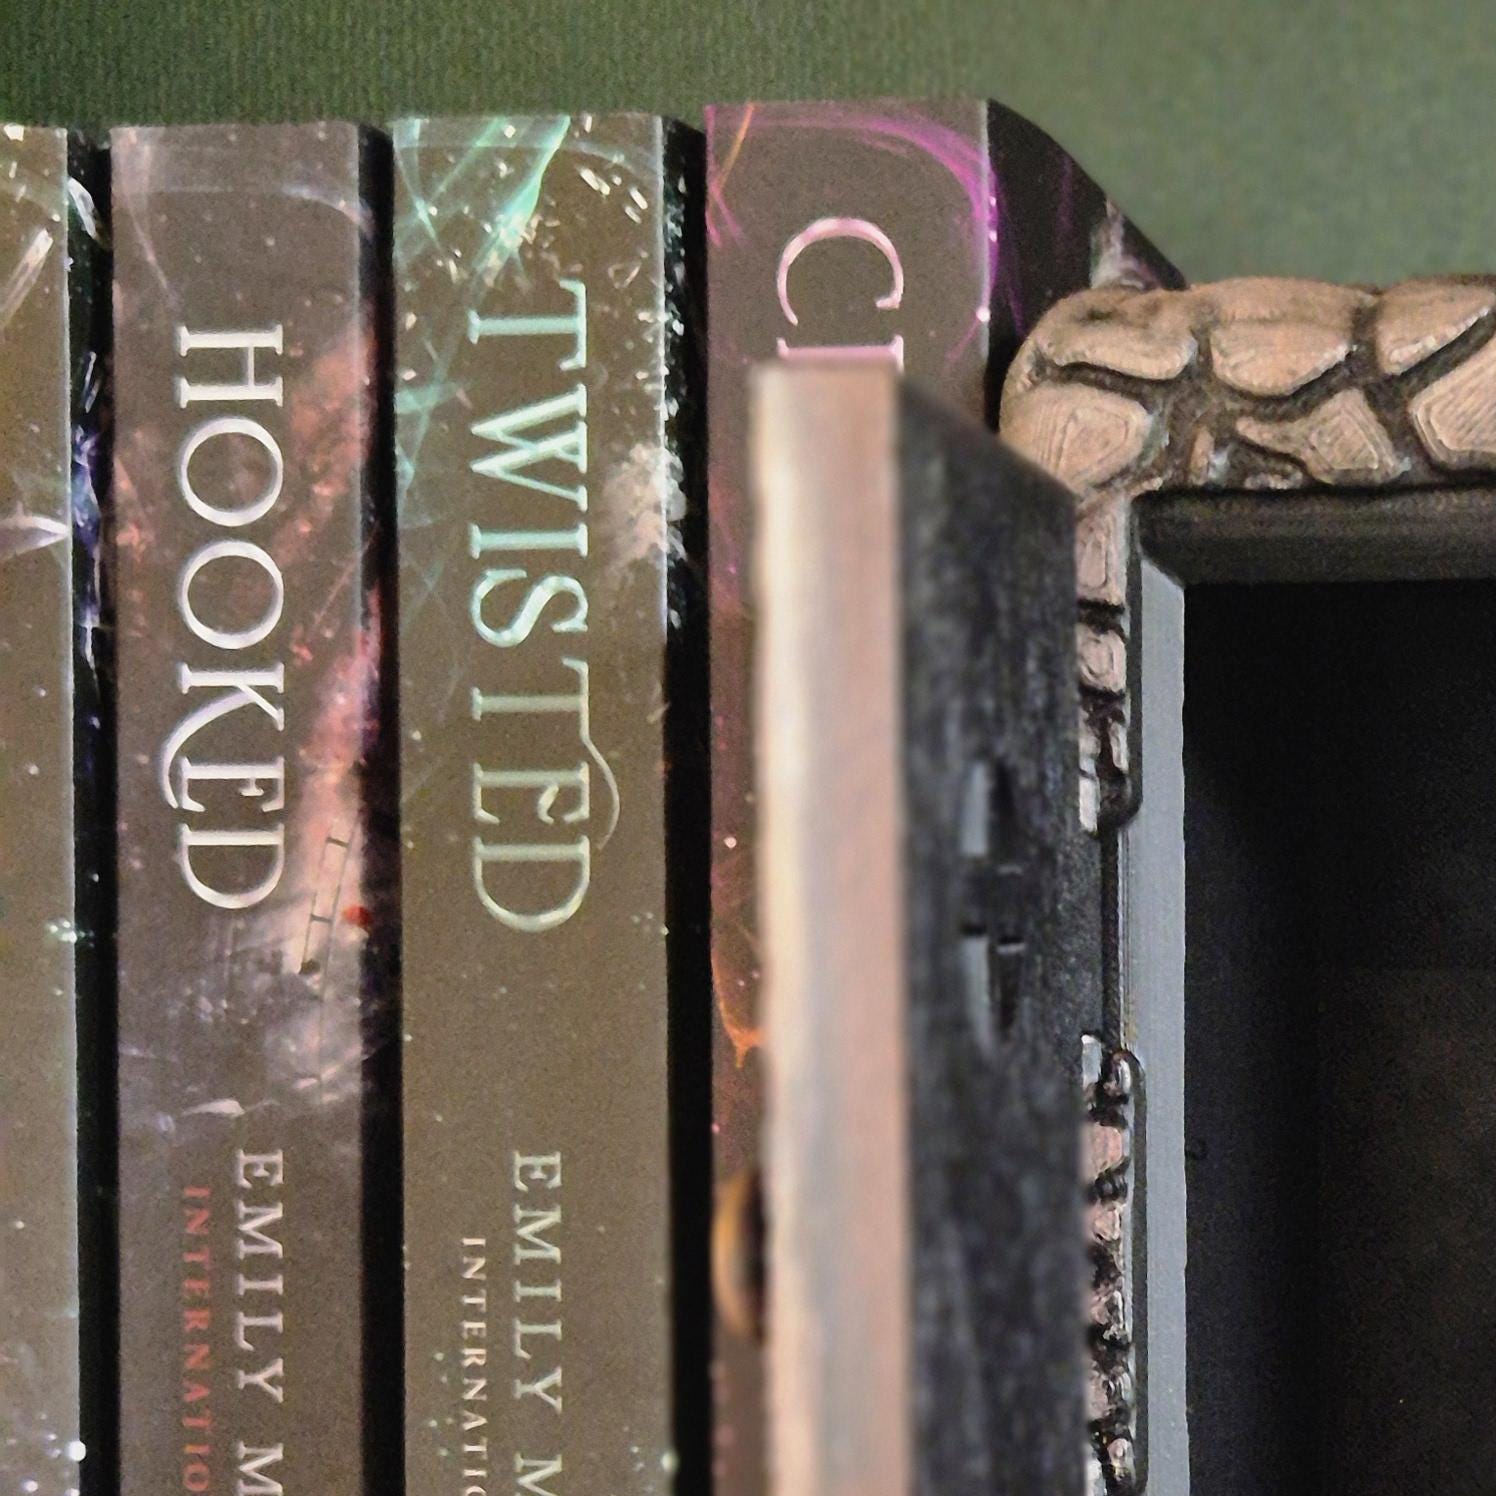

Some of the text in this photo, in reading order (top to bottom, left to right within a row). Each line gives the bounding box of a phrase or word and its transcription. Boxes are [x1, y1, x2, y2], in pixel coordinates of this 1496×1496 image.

[161, 324, 285, 910] HOOKED
[468, 279, 620, 934] TWISTED
[235, 1148, 285, 1403] EMILY
[514, 1150, 565, 1412] EMILY
